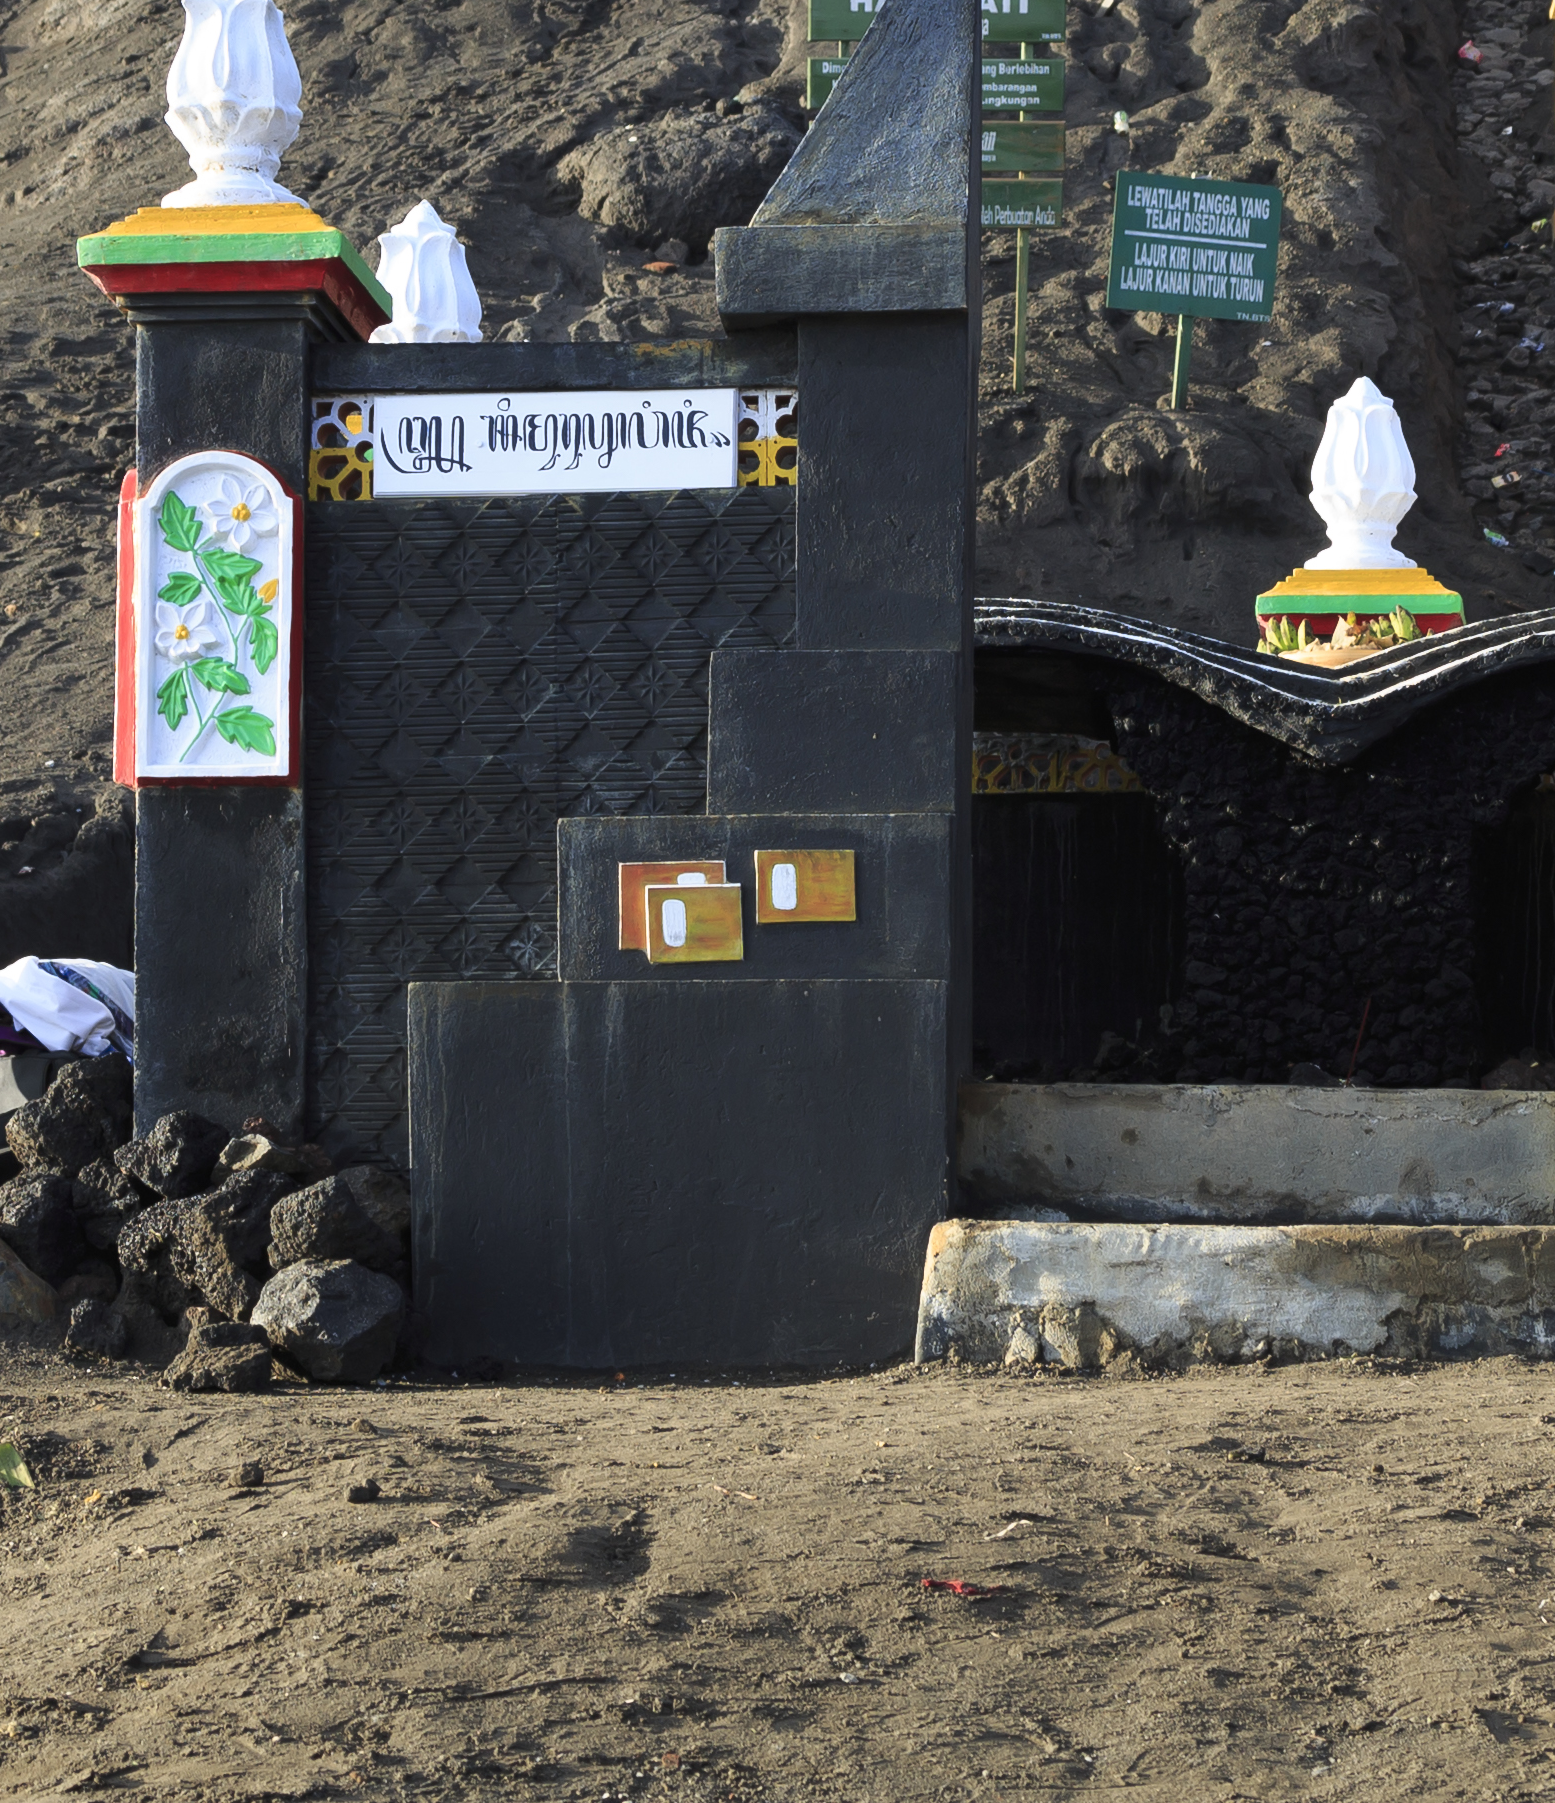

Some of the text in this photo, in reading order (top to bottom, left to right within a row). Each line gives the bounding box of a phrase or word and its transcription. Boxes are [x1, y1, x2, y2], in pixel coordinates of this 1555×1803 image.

[982, 82, 1037, 94] mbarangan
[1127, 185, 1270, 219] LEWATILAH TANGGA YANG
[1145, 209, 1250, 238] TELAH DISEDIAKAN
[1134, 242, 1254, 277] LAJUR KIRI UNTUK NAIK
[1120, 266, 1264, 302] LAJUR KANAN UNTUK TURUN
